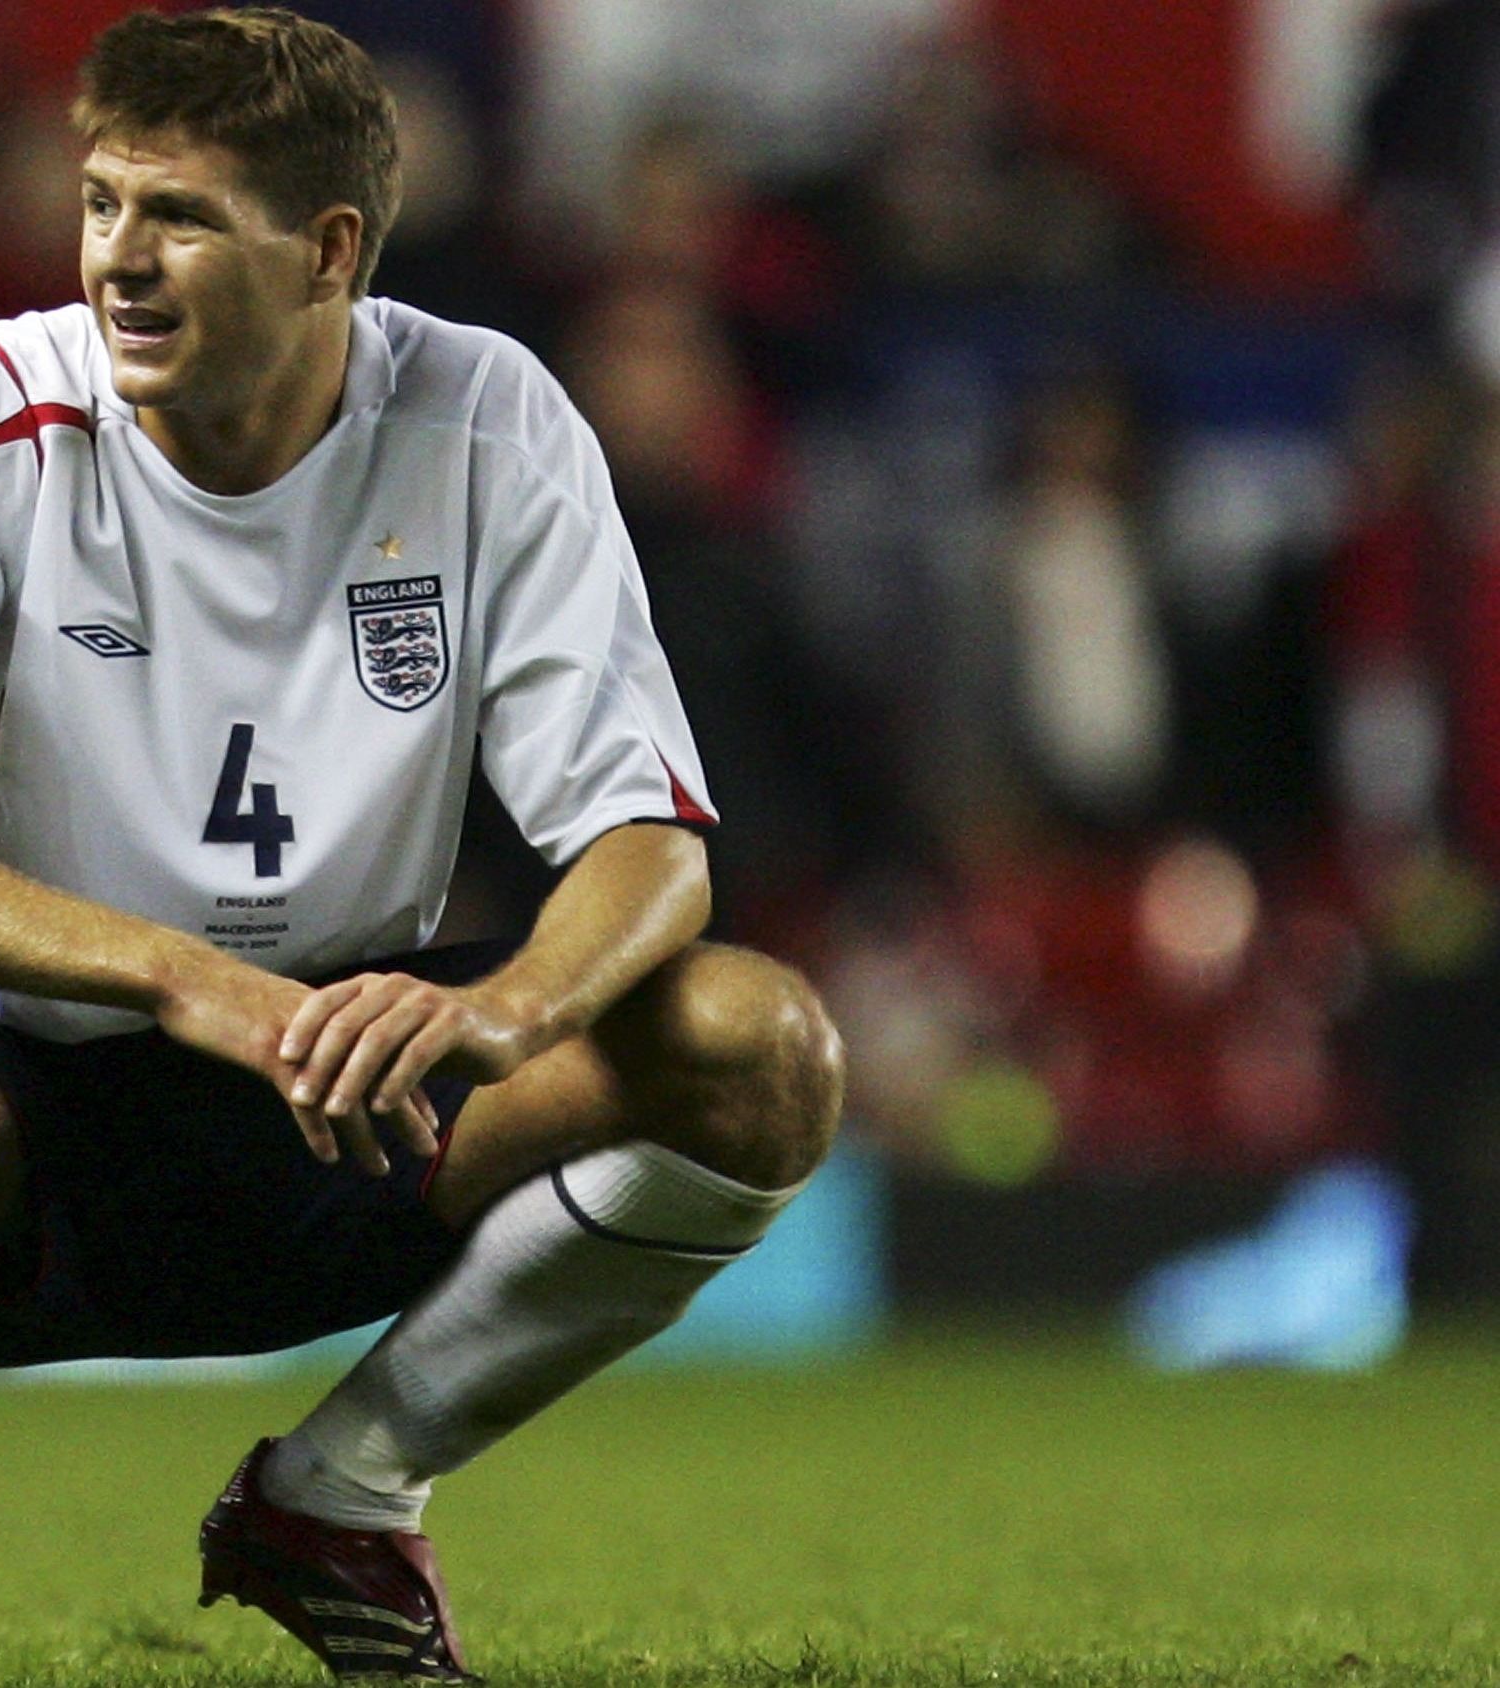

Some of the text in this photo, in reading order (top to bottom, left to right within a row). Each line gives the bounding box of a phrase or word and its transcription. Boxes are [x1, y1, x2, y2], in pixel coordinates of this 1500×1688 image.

[354, 580, 436, 603] ENGLAND
[202, 723, 295, 877] 4
[216, 897, 286, 908] ENGLAND
[204, 923, 289, 935] MACEDONIA
